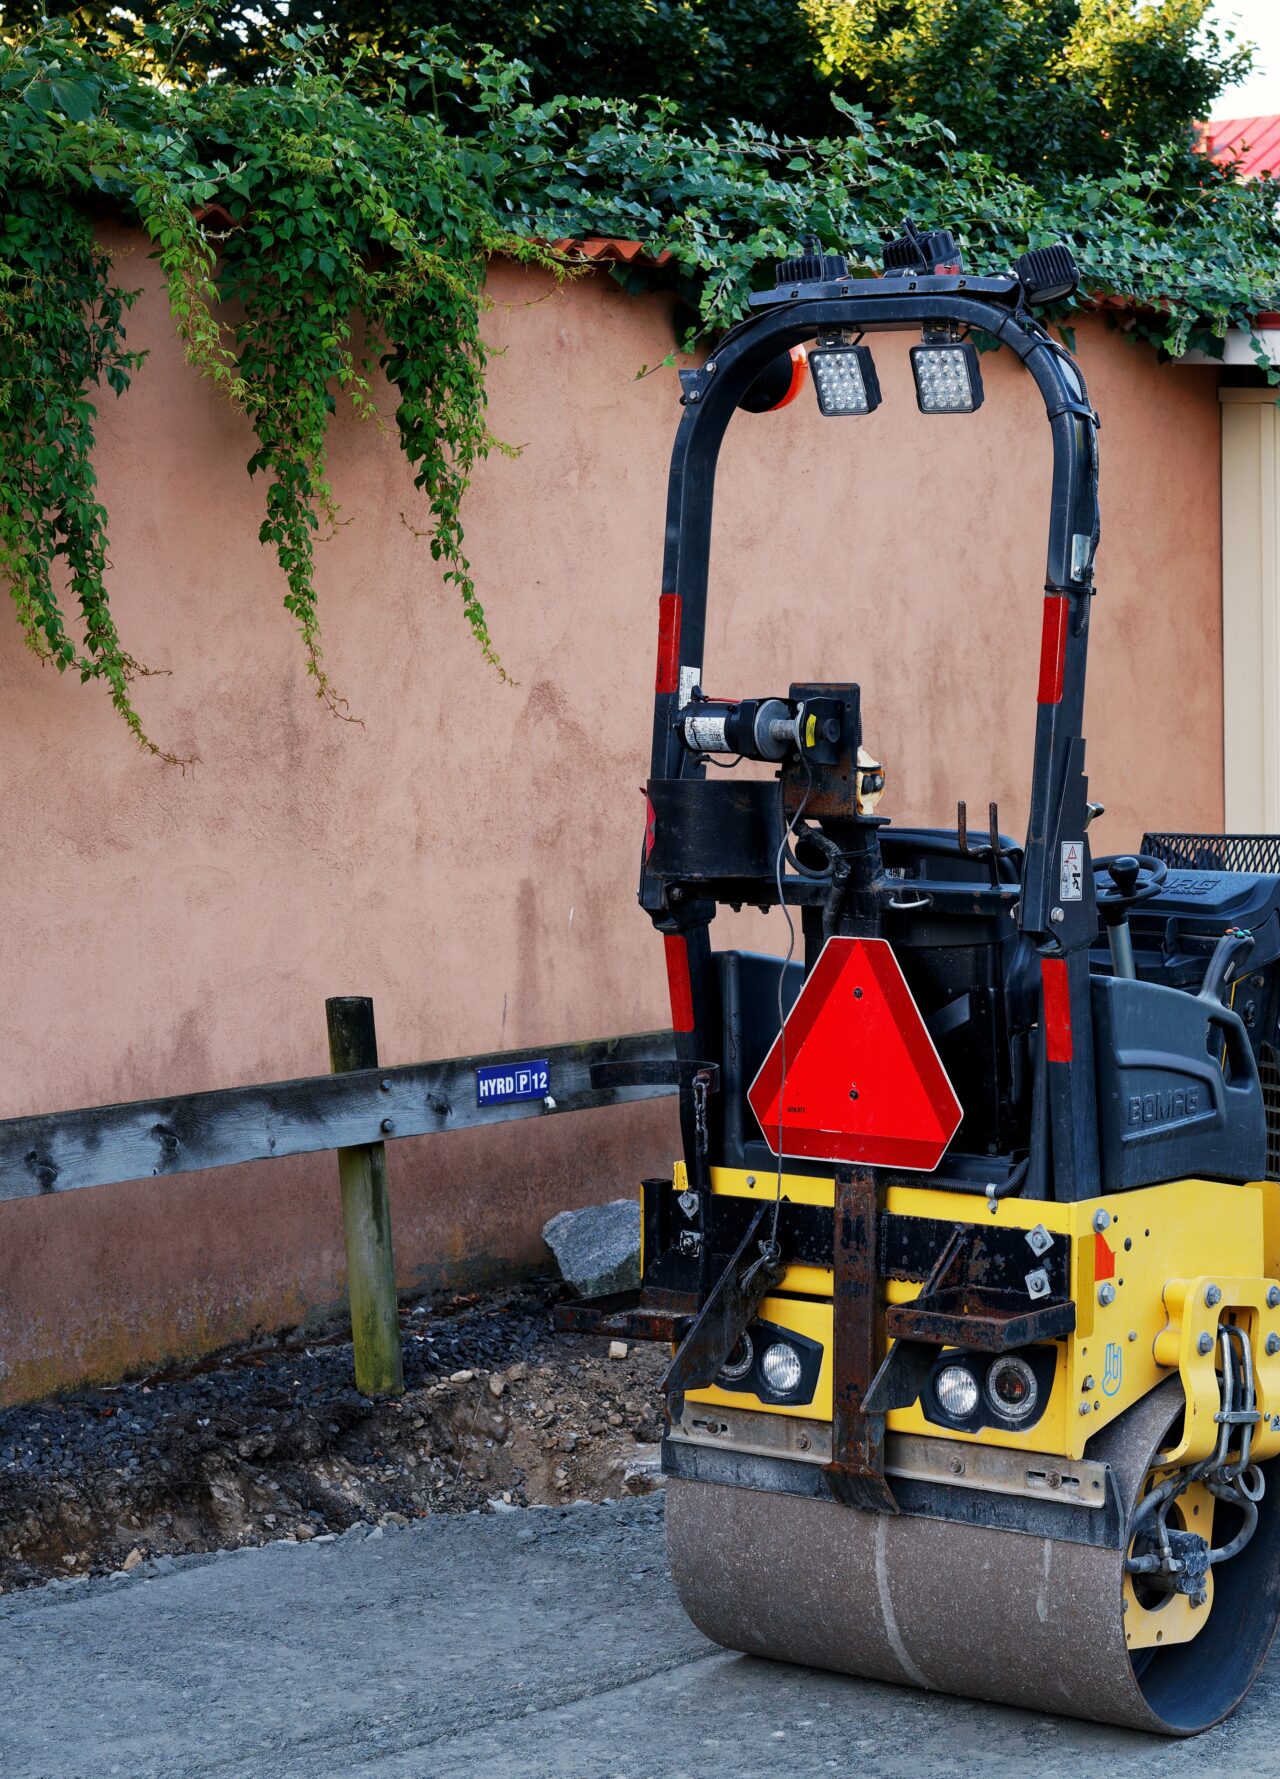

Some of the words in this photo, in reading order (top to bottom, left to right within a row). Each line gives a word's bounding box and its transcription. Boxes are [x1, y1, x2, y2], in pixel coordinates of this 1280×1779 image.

[480, 1076, 514, 1097] HYRD
[520, 1074, 528, 1091] P
[532, 1072, 547, 1090] 12
[1128, 1086, 1199, 1126] BOMAG
